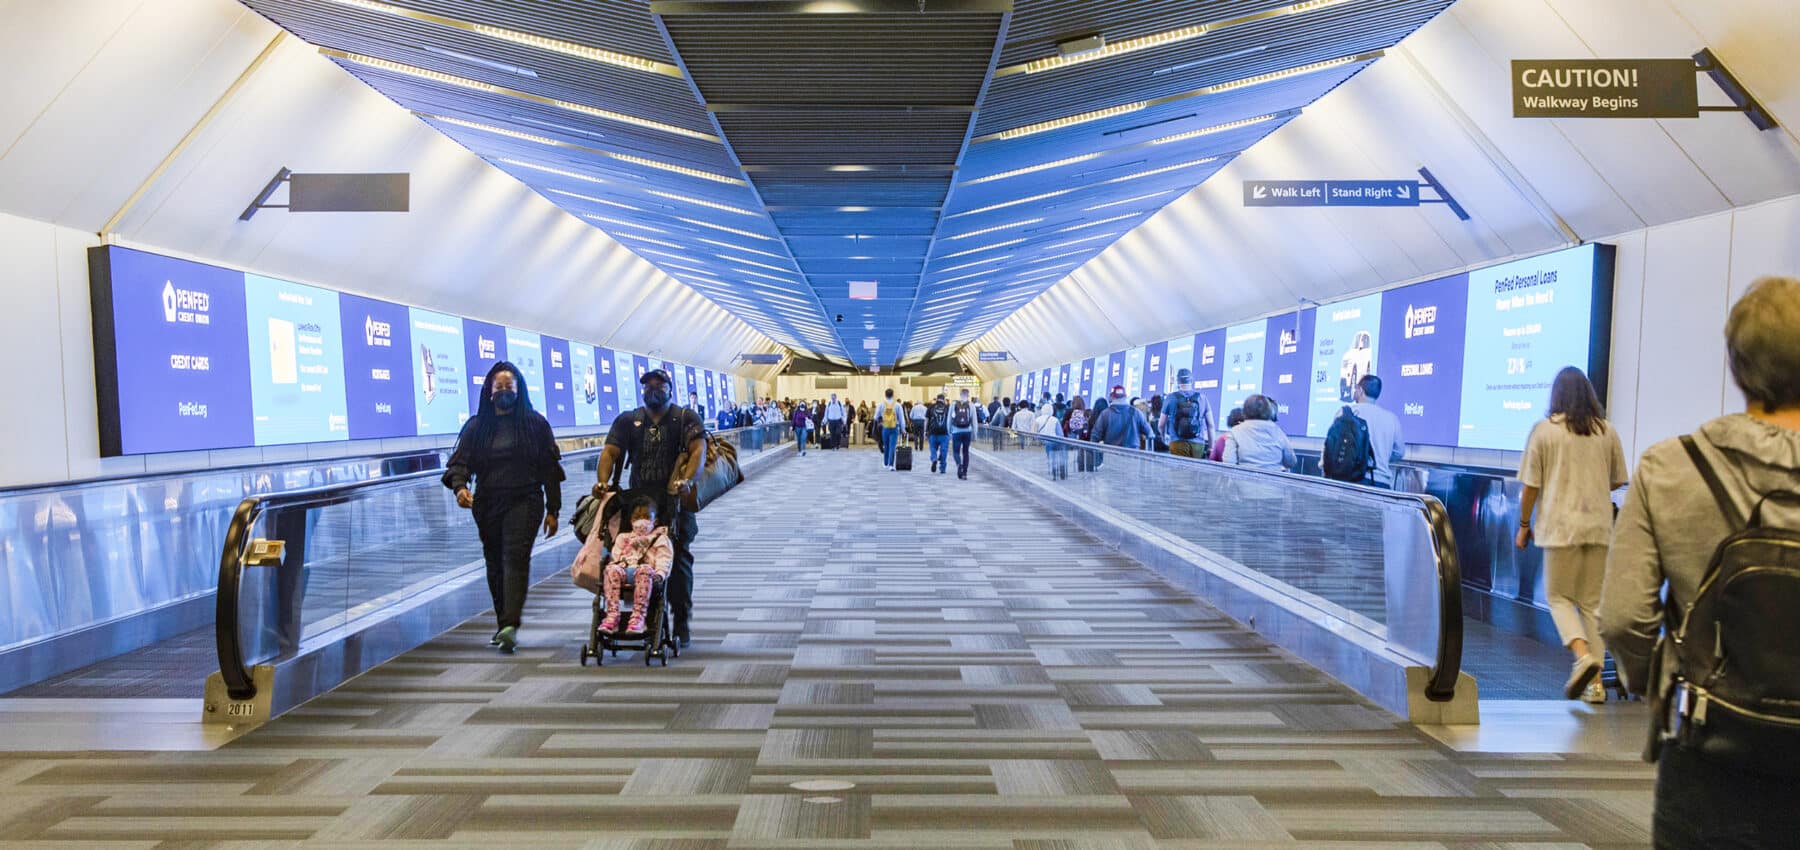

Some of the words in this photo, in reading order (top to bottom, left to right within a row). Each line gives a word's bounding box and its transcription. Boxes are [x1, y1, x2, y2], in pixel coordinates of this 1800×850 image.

[1521, 68, 1638, 88] CAUTION!
[1523, 95, 1588, 111] Walkway
[1592, 95, 1639, 111] Begins
[1271, 187, 1298, 198] Walk
[1300, 187, 1321, 198] Left
[1332, 187, 1362, 198] Stand
[1364, 187, 1393, 200] Right
[1515, 270, 1539, 290] Personal
[1540, 270, 1558, 286] Loans
[176, 288, 209, 311] PENFED
[170, 354, 190, 369] CREDIT
[229, 703, 253, 716] 2011
